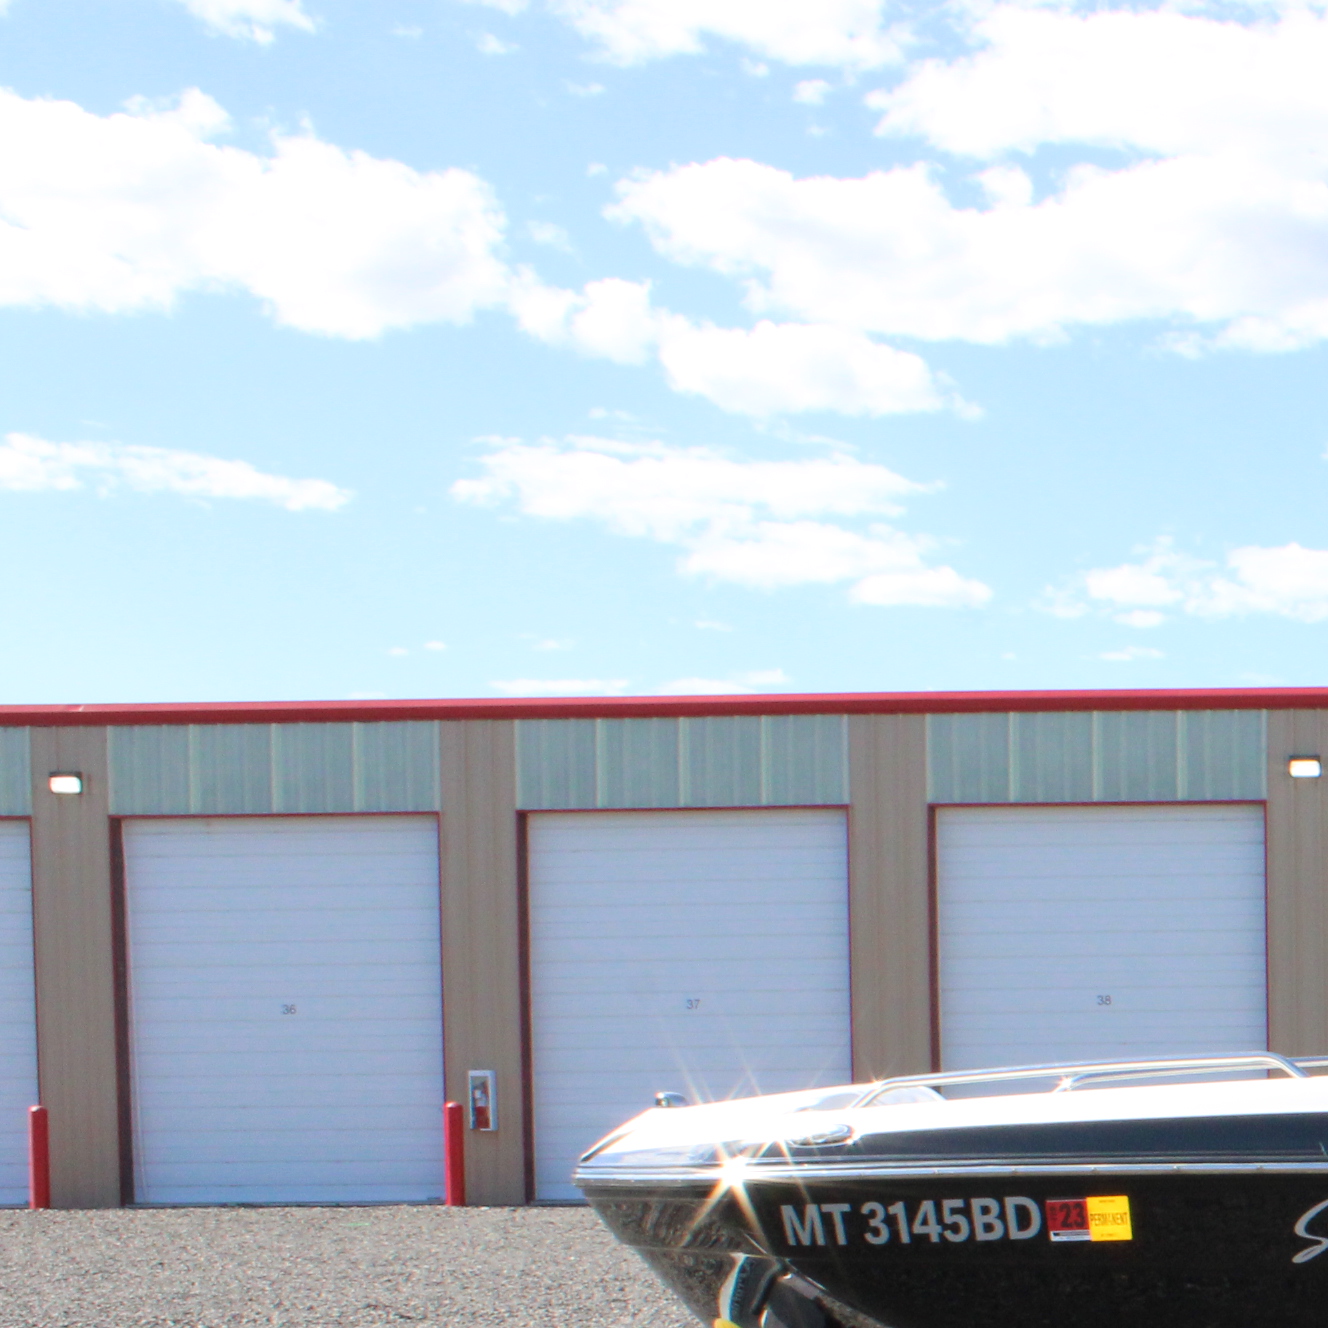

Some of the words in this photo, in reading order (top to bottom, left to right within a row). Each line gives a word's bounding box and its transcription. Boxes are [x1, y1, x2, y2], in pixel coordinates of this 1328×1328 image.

[282, 1004, 297, 1015] 36
[686, 998, 701, 1010] 37
[780, 1202, 852, 1247] MT
[860, 1195, 1042, 1246] 3145BD
[1059, 1202, 1086, 1228] 23
